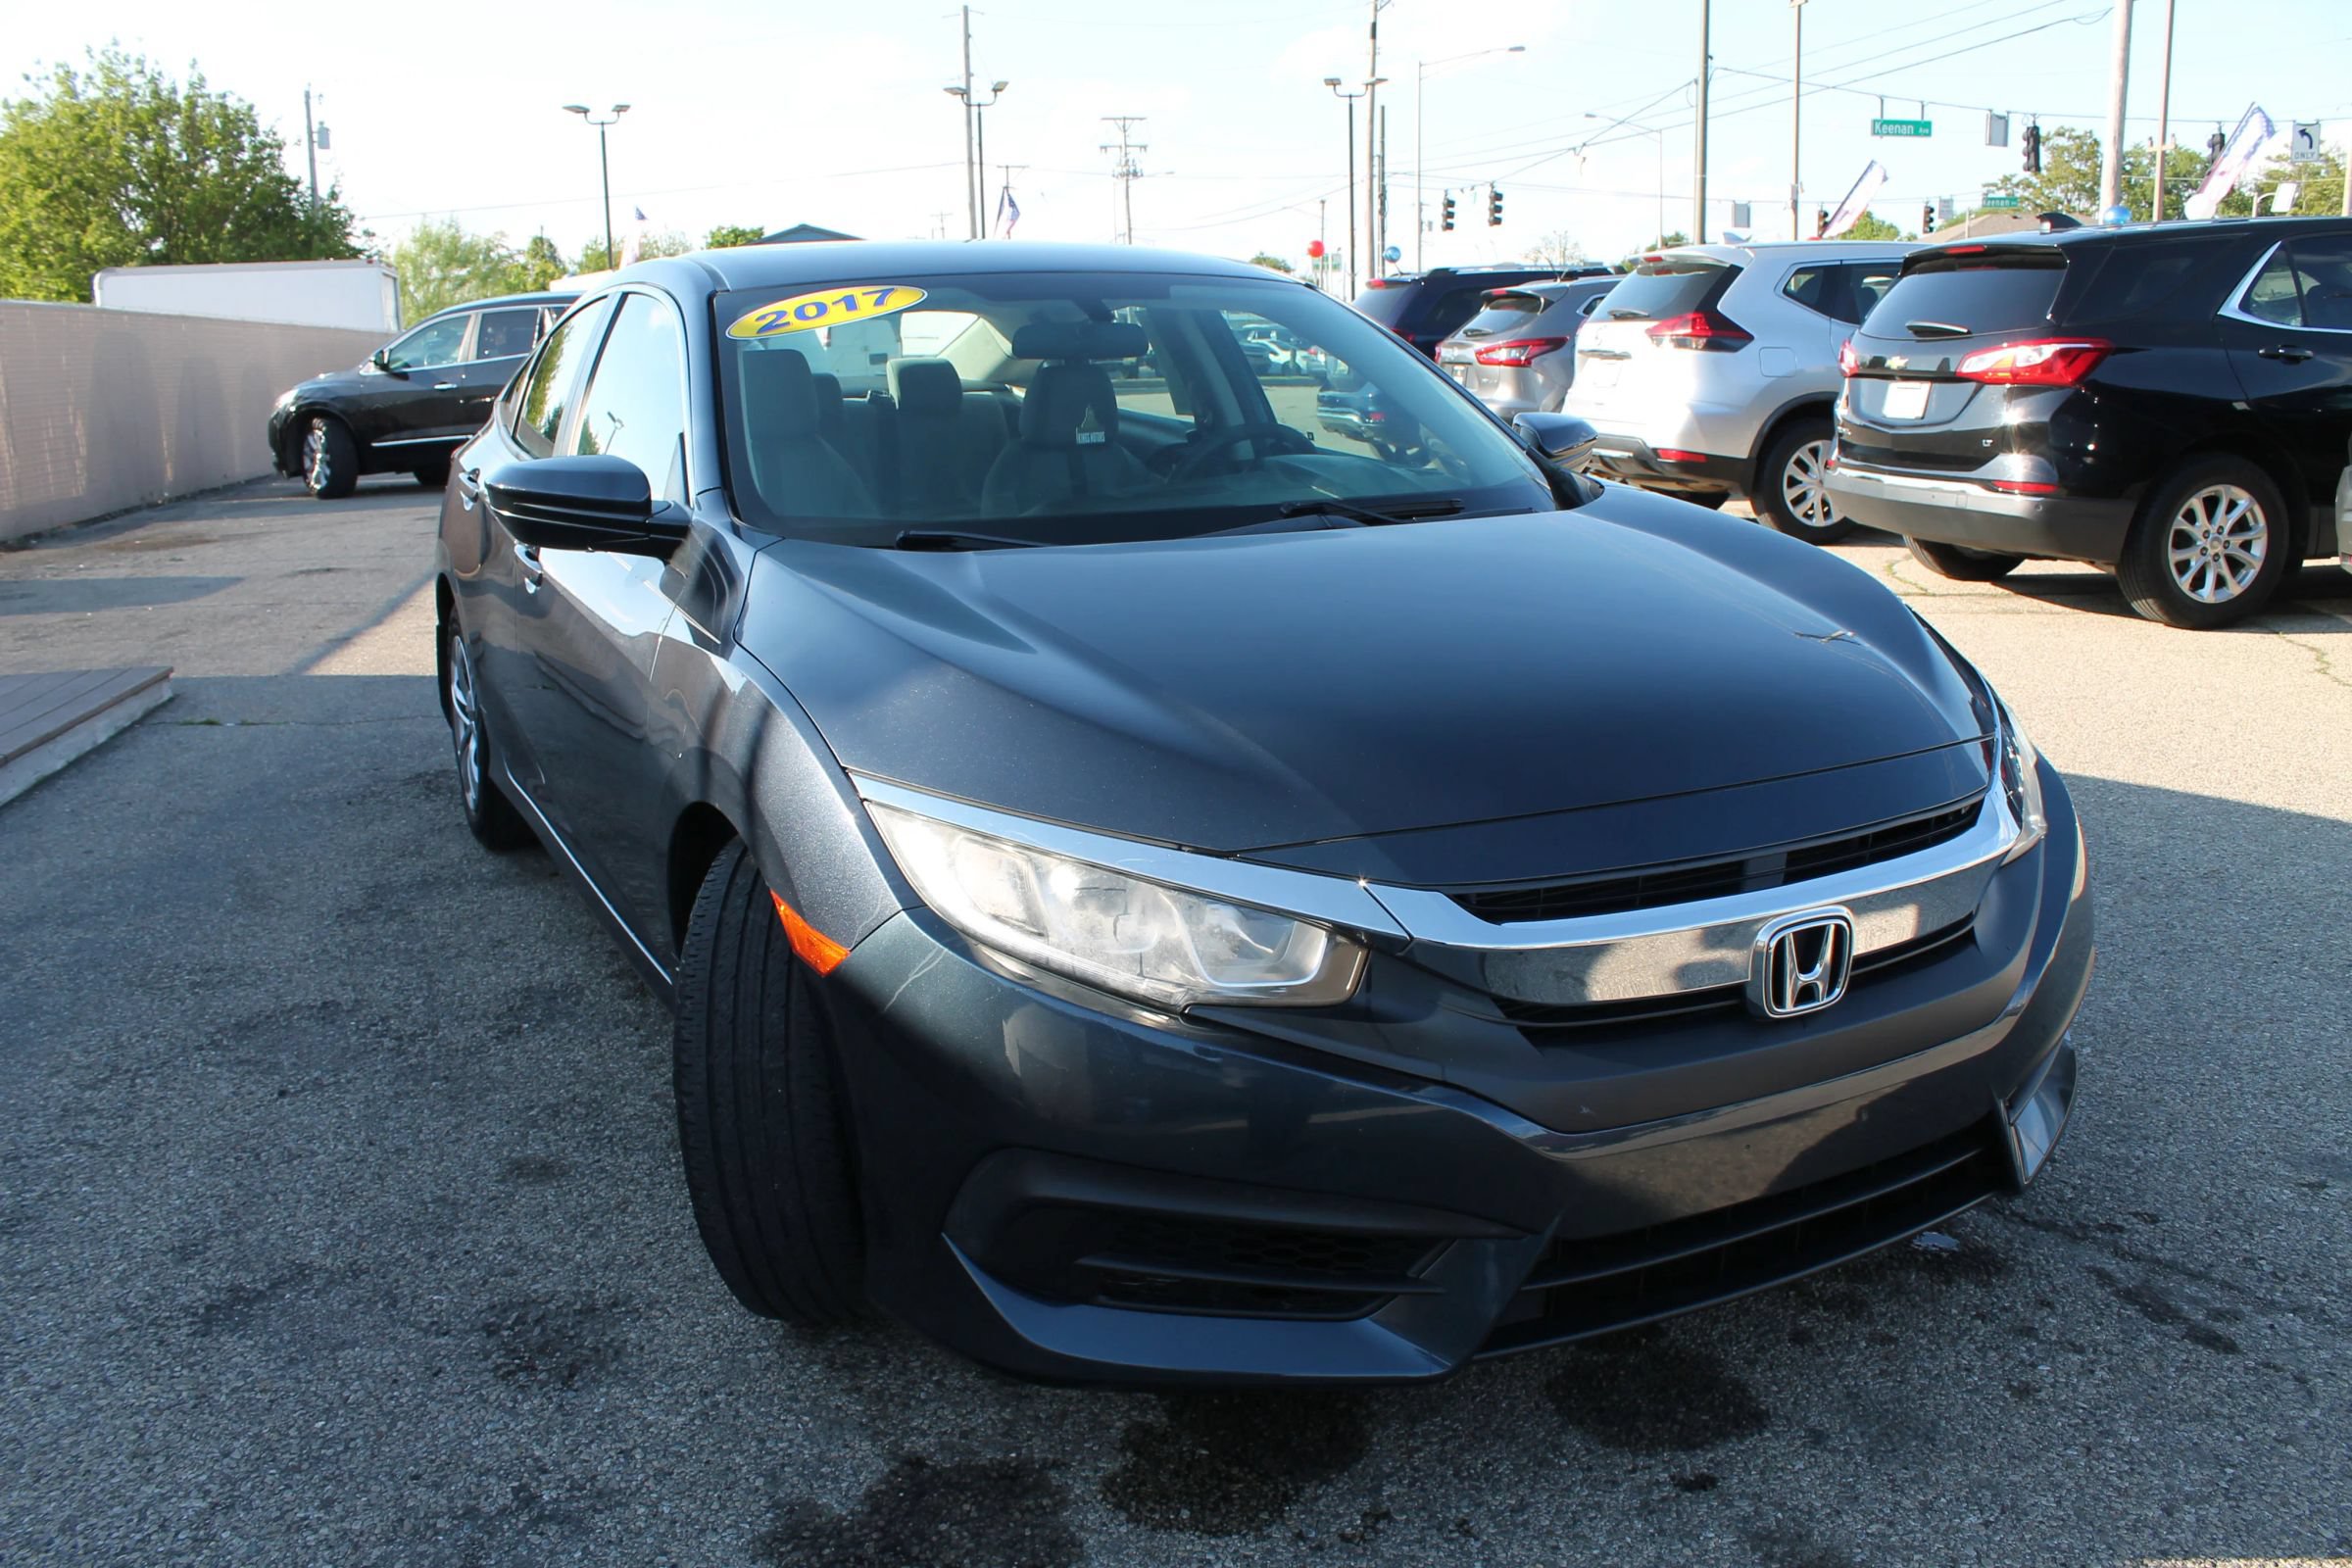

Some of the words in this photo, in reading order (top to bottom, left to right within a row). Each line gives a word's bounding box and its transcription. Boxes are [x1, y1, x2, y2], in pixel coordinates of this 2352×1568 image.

[1874, 121, 1914, 135] Keenan
[2294, 151, 2316, 160] ONLY
[755, 288, 899, 335] 2017
